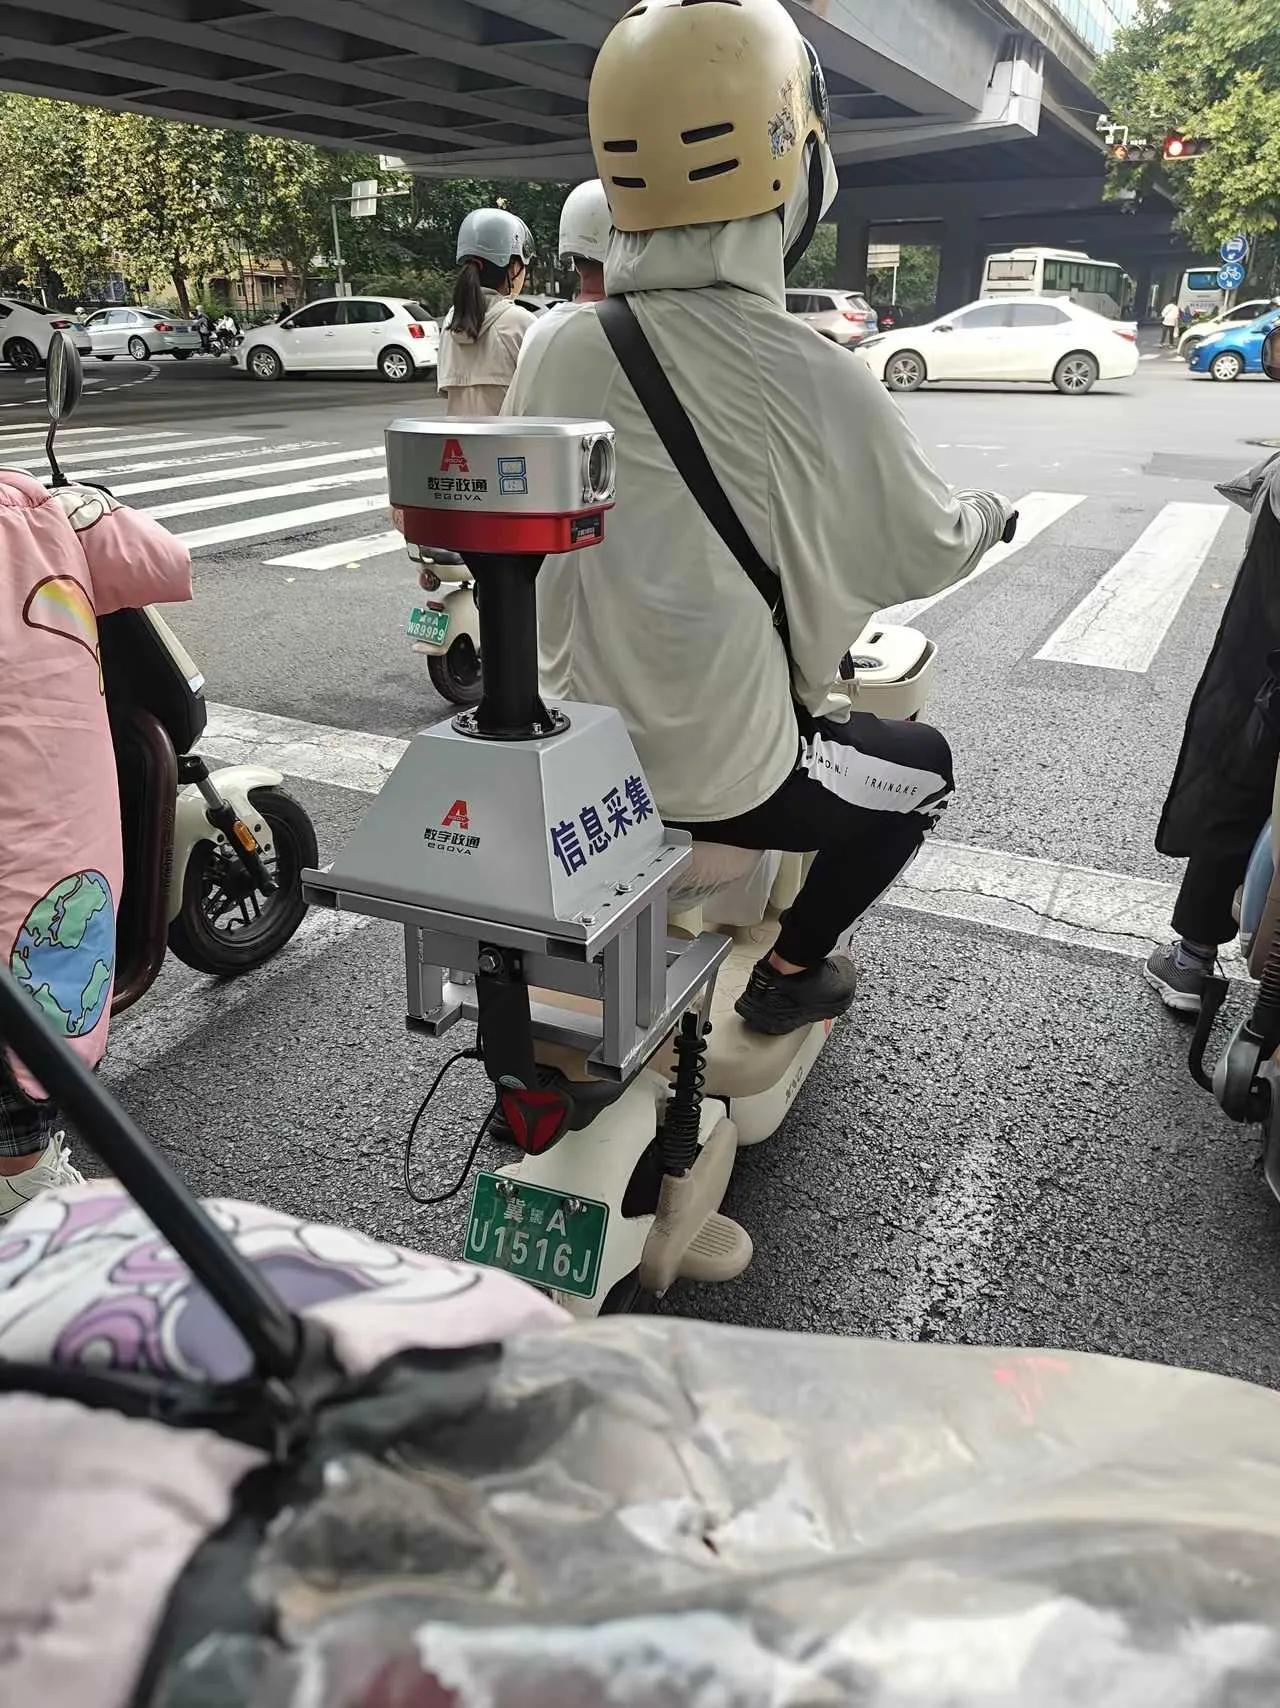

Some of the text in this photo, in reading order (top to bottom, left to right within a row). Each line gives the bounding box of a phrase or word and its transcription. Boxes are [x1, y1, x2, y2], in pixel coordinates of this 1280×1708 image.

[427, 476, 488, 492] 数字政通
[424, 828, 481, 849] 数字政通
[550, 775, 654, 877] 信息采集
[470, 1217, 592, 1283] U1516J
